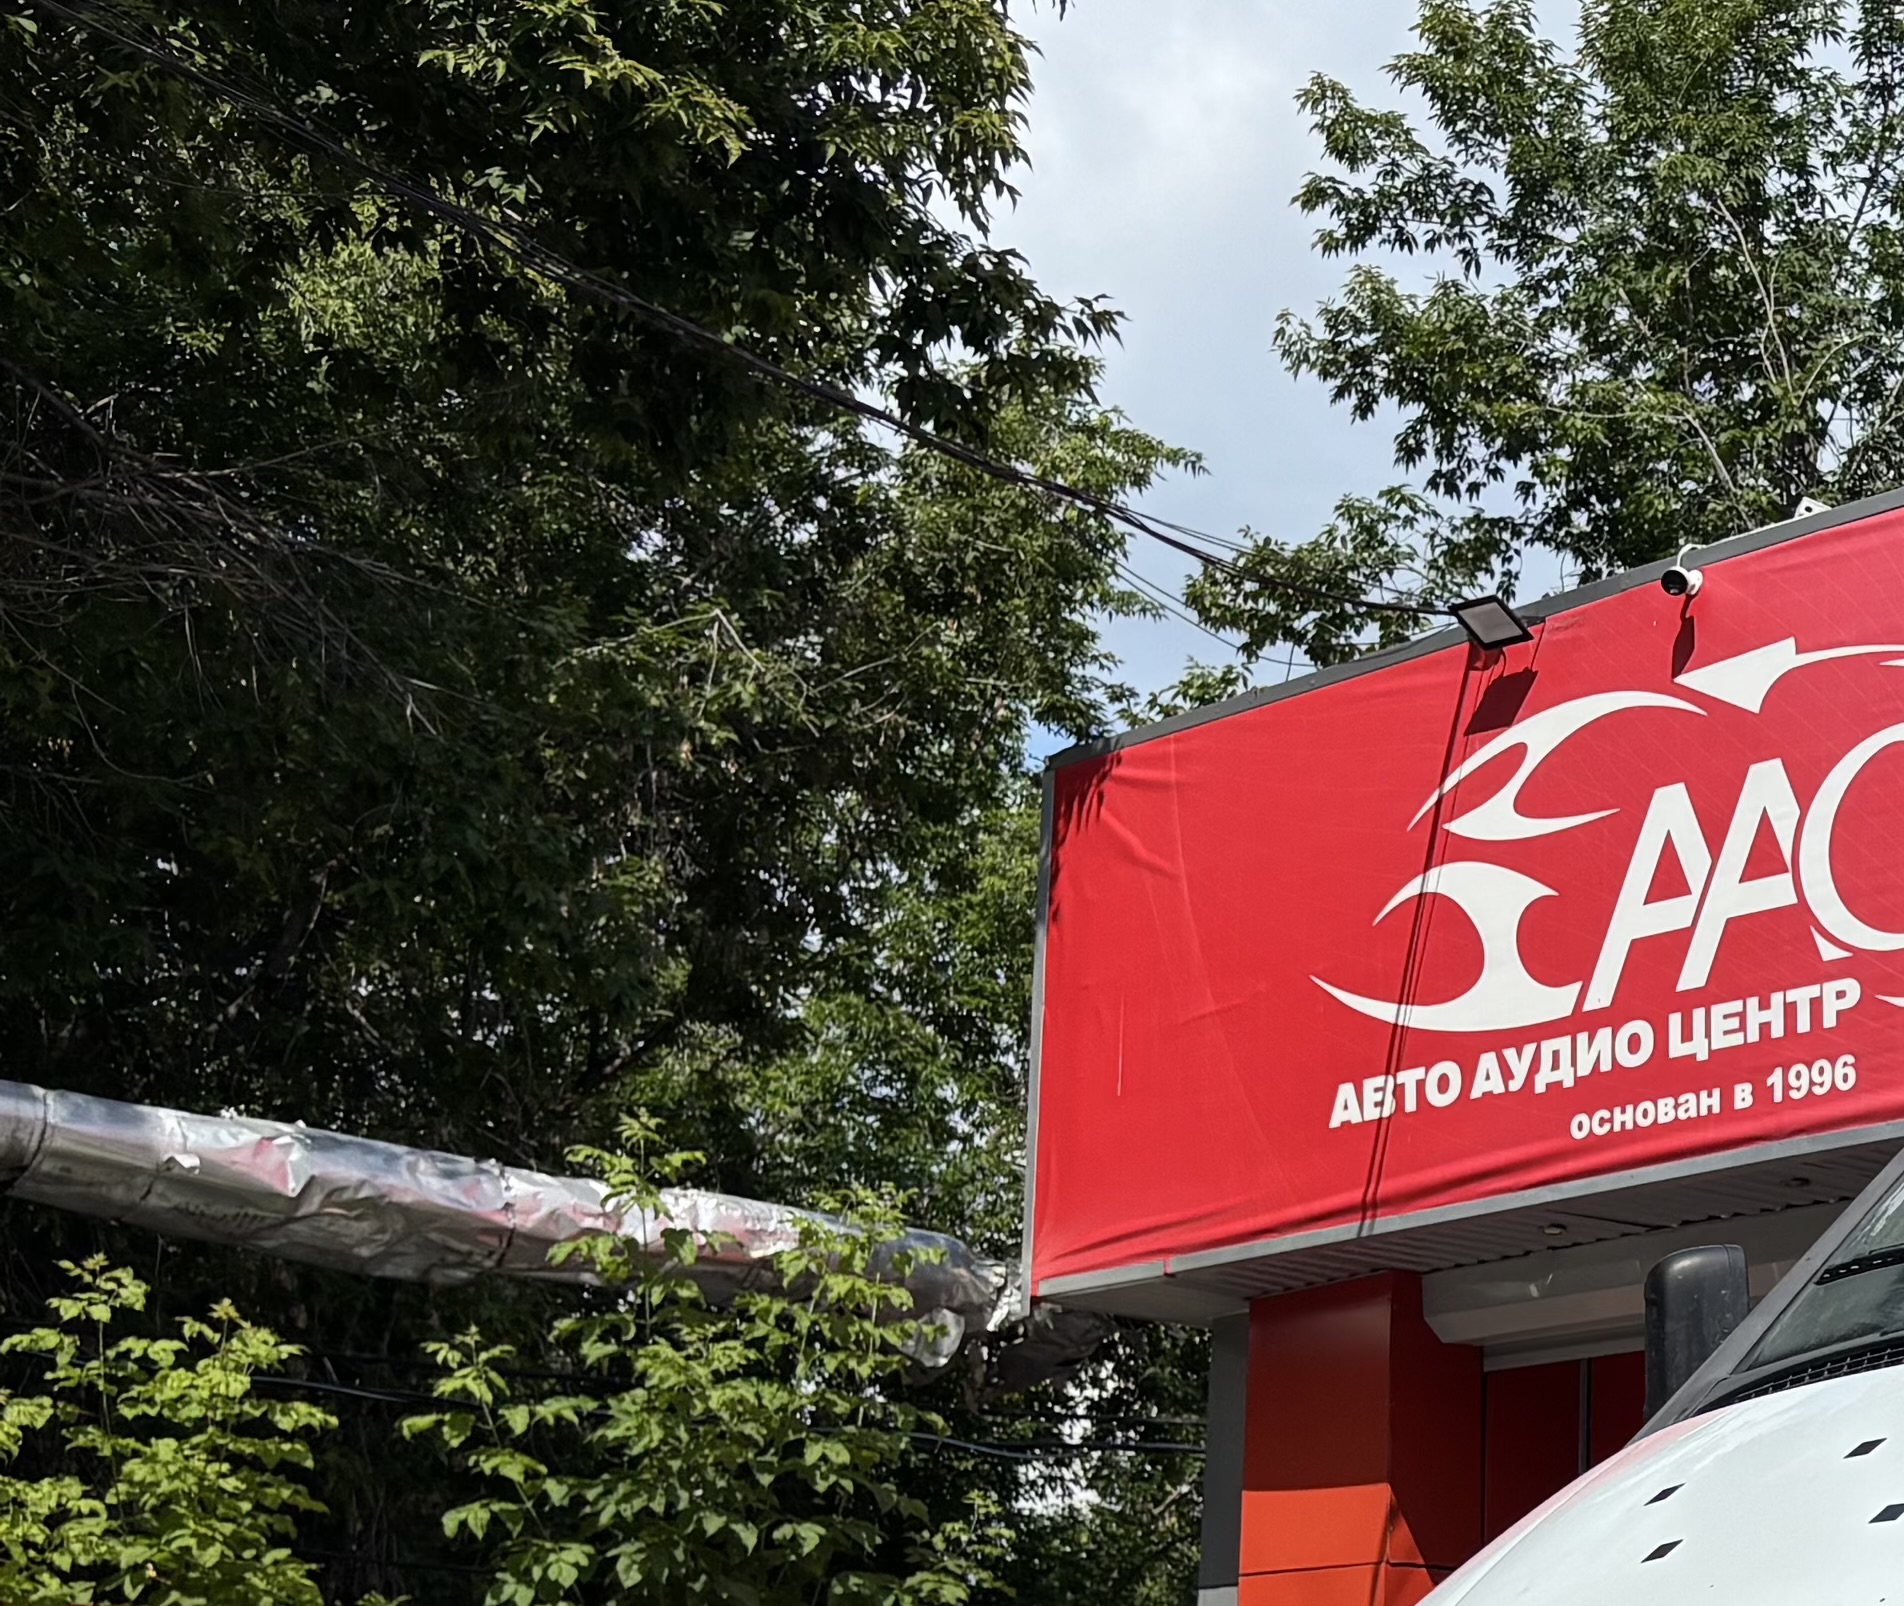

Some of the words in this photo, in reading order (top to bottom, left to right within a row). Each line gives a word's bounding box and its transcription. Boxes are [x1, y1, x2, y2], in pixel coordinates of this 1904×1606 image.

[1328, 1060, 1462, 1129] АВТО
[1469, 1019, 1655, 1100] АУДИО
[1667, 976, 1862, 1062] ЦЕНТР
[1569, 1084, 1721, 1140] основан
[1732, 1082, 1754, 1112] в
[1766, 1054, 1857, 1105] 1996
